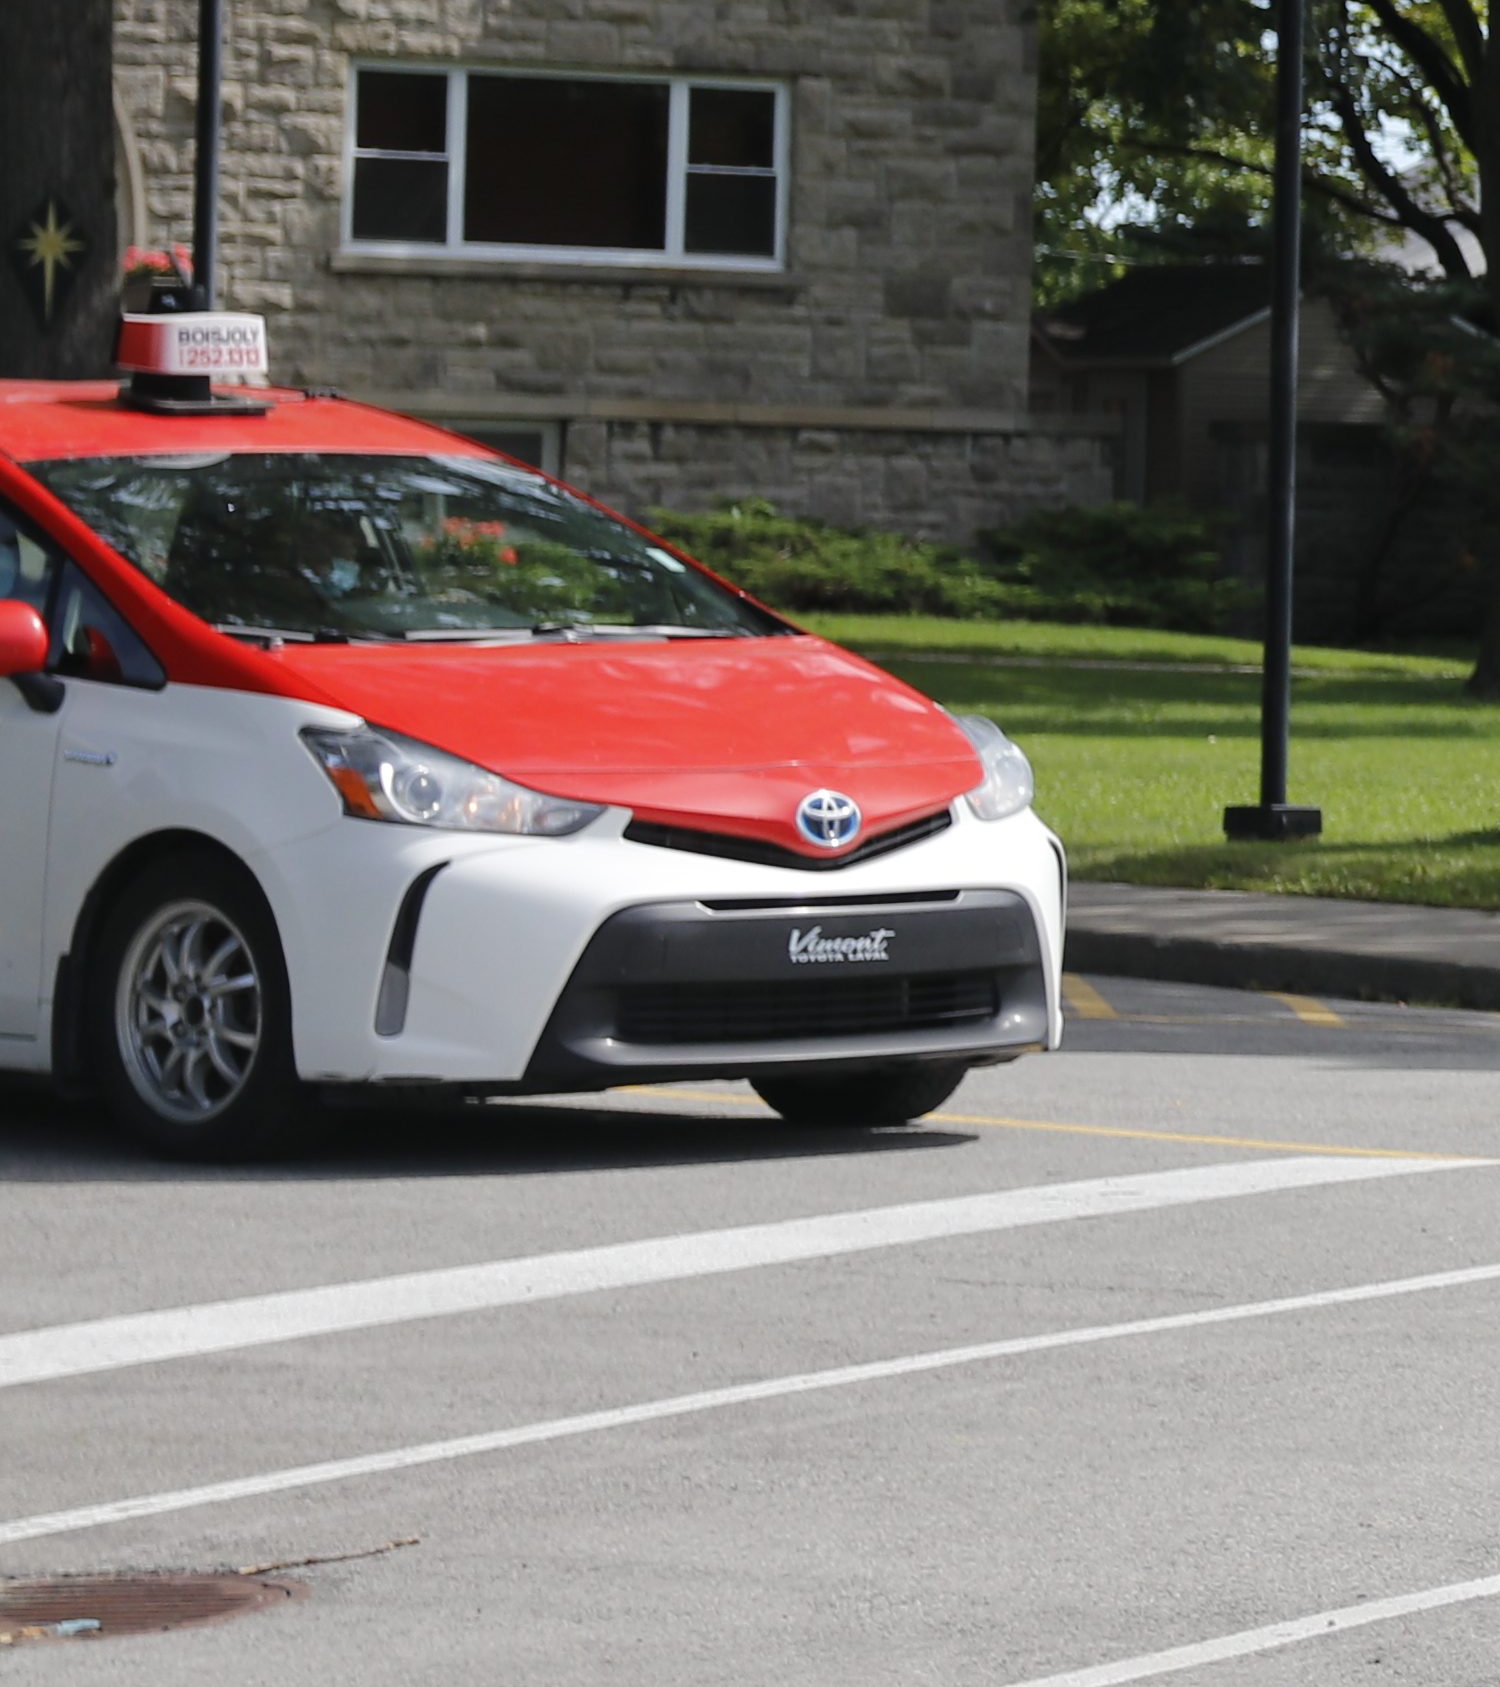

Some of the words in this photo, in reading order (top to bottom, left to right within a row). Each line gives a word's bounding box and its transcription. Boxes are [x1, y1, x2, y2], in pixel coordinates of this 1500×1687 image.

[178, 326, 260, 346] BOISJOLY
[788, 924, 897, 954] Vimont
[790, 951, 844, 964] TOYOTA
